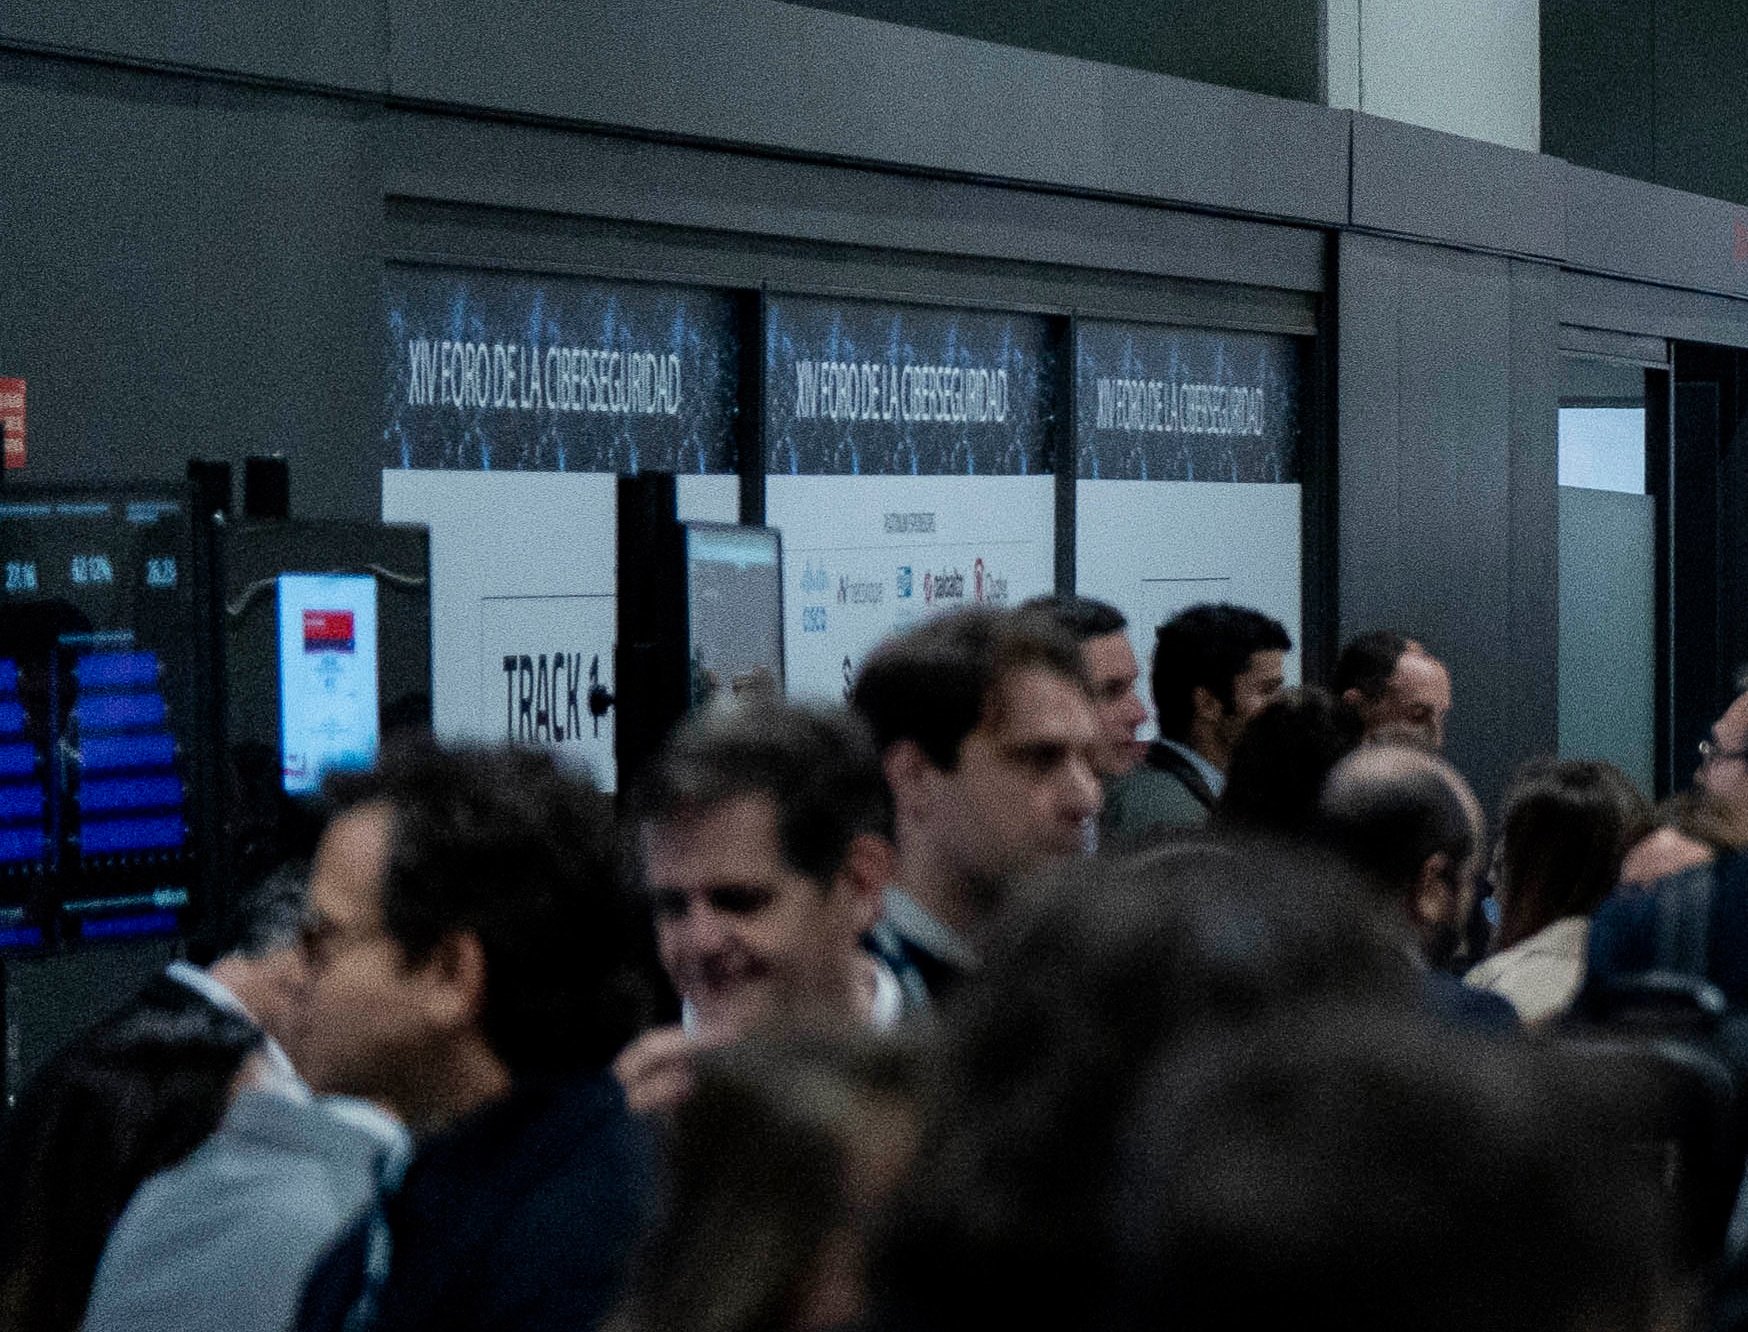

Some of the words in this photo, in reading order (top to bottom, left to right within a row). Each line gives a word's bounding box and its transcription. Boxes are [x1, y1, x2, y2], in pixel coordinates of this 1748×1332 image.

[408, 340, 439, 405] XIV
[441, 341, 491, 408] FORO
[493, 343, 517, 409] DE
[520, 346, 542, 410] LA
[545, 346, 681, 415] CIBERSEGURIDAD
[795, 360, 819, 418] XIV
[820, 361, 860, 420] FORO
[861, 362, 880, 420] DE
[881, 364, 900, 420] LA
[901, 365, 1008, 423] CIBERSEGURIDAD
[503, 652, 582, 744] TRACK
